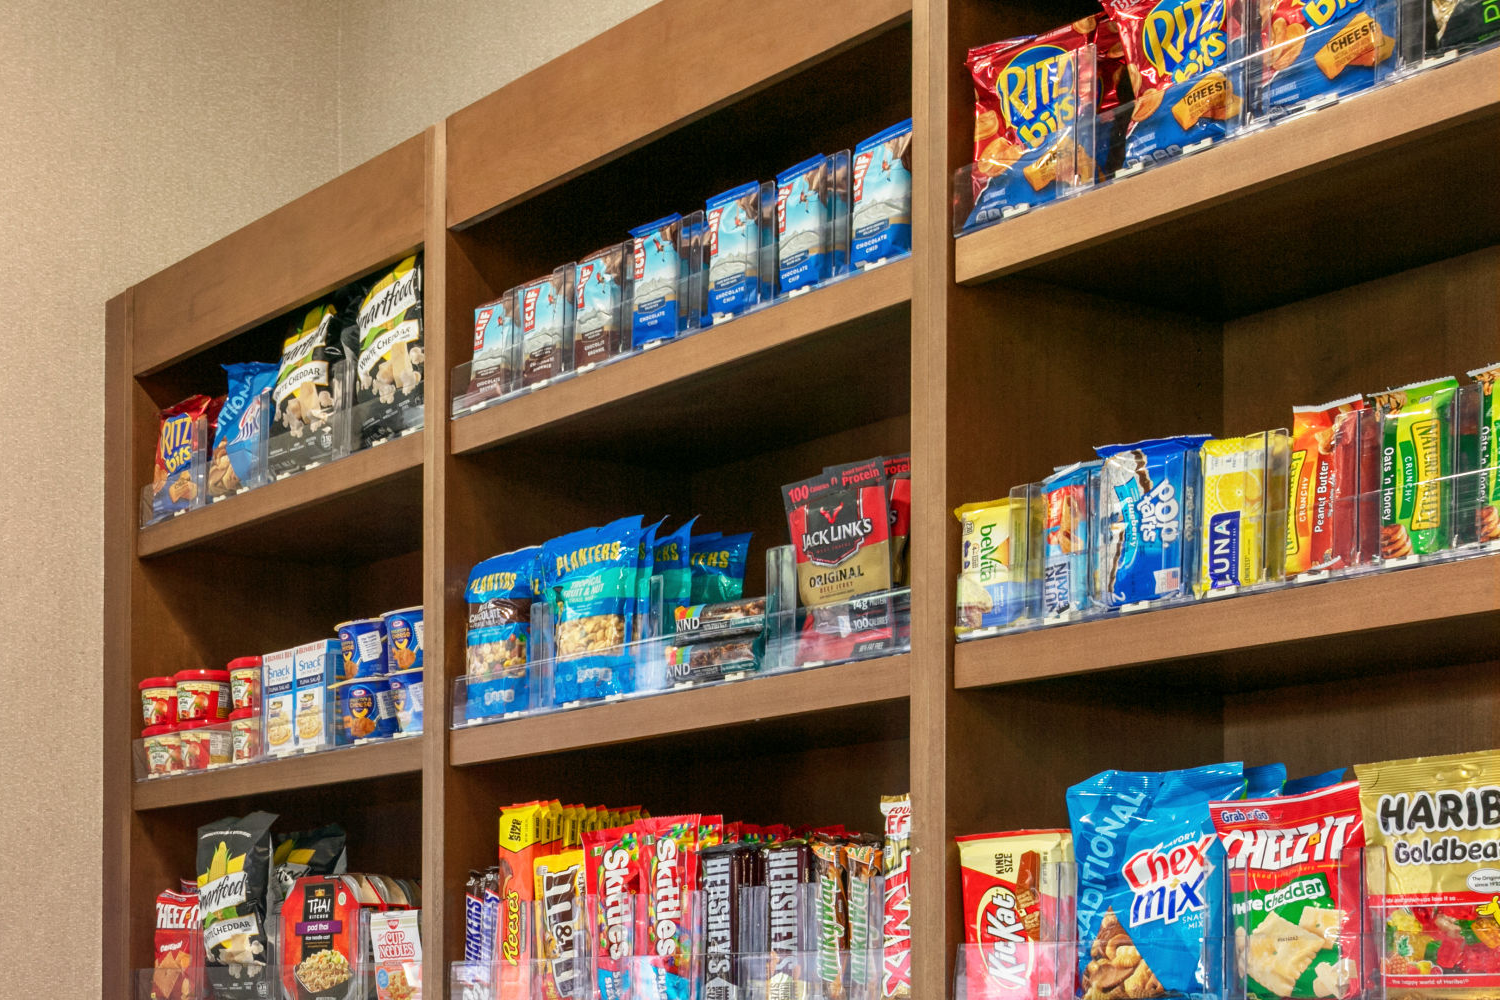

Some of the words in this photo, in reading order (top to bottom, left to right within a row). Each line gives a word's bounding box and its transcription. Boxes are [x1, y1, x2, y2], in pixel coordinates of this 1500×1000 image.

[1149, 0, 1221, 76] RITZ
[1330, 20, 1376, 53] CHEESE
[1174, 33, 1227, 84] bits
[999, 54, 1072, 129] RITZ
[1186, 80, 1230, 105] CHEESE
[1019, 98, 1077, 149] bits
[359, 345, 376, 371] WHITE
[288, 366, 321, 384] CHEDDAR
[161, 413, 191, 456] RITZ
[1481, 426, 1491, 453] Oats
[165, 445, 191, 474] bits
[1383, 447, 1394, 472] Oats
[842, 468, 880, 486] Protein
[1317, 461, 1329, 494] Butter
[1404, 455, 1412, 503] CRUNCHY
[788, 485, 809, 503] 100
[1299, 477, 1309, 522] CRUNCHY
[1382, 487, 1394, 521] Honey
[1125, 497, 1139, 548] Blueberry
[1314, 497, 1325, 533] Peanut
[802, 526, 829, 550] JACK
[830, 518, 872, 543] LINK'S
[556, 541, 622, 576] PLANTERS
[980, 523, 1002, 583] belVita
[1213, 519, 1232, 585] LUNA
[469, 572, 517, 594] PLANTERS
[571, 575, 601, 588] TROPICAL
[583, 587, 591, 596] &
[592, 583, 605, 594] NUT
[809, 565, 864, 588] ORIGINAL
[675, 617, 700, 632] KIND
[853, 619, 868, 629] 100
[268, 665, 291, 679] Snack
[299, 657, 322, 672] Snack
[1222, 810, 1245, 822] Grab
[1254, 810, 1268, 821] Go
[995, 853, 1004, 874] KING
[1005, 853, 1013, 873] SIZE
[1124, 836, 1213, 889] Chex
[308, 898, 331, 914] THAI
[604, 849, 634, 961] Skittles
[656, 838, 682, 957] Skittles
[1132, 872, 1206, 923] mix
[1266, 880, 1323, 911] cheddar
[212, 920, 251, 936] CHEDDAR
[307, 923, 318, 932] pad
[706, 856, 731, 974] HERSHEY'S
[1188, 921, 1205, 929] MIX
[378, 943, 415, 959] NOODLES
[385, 931, 405, 945] CUP
[987, 892, 1027, 986] KitKat
